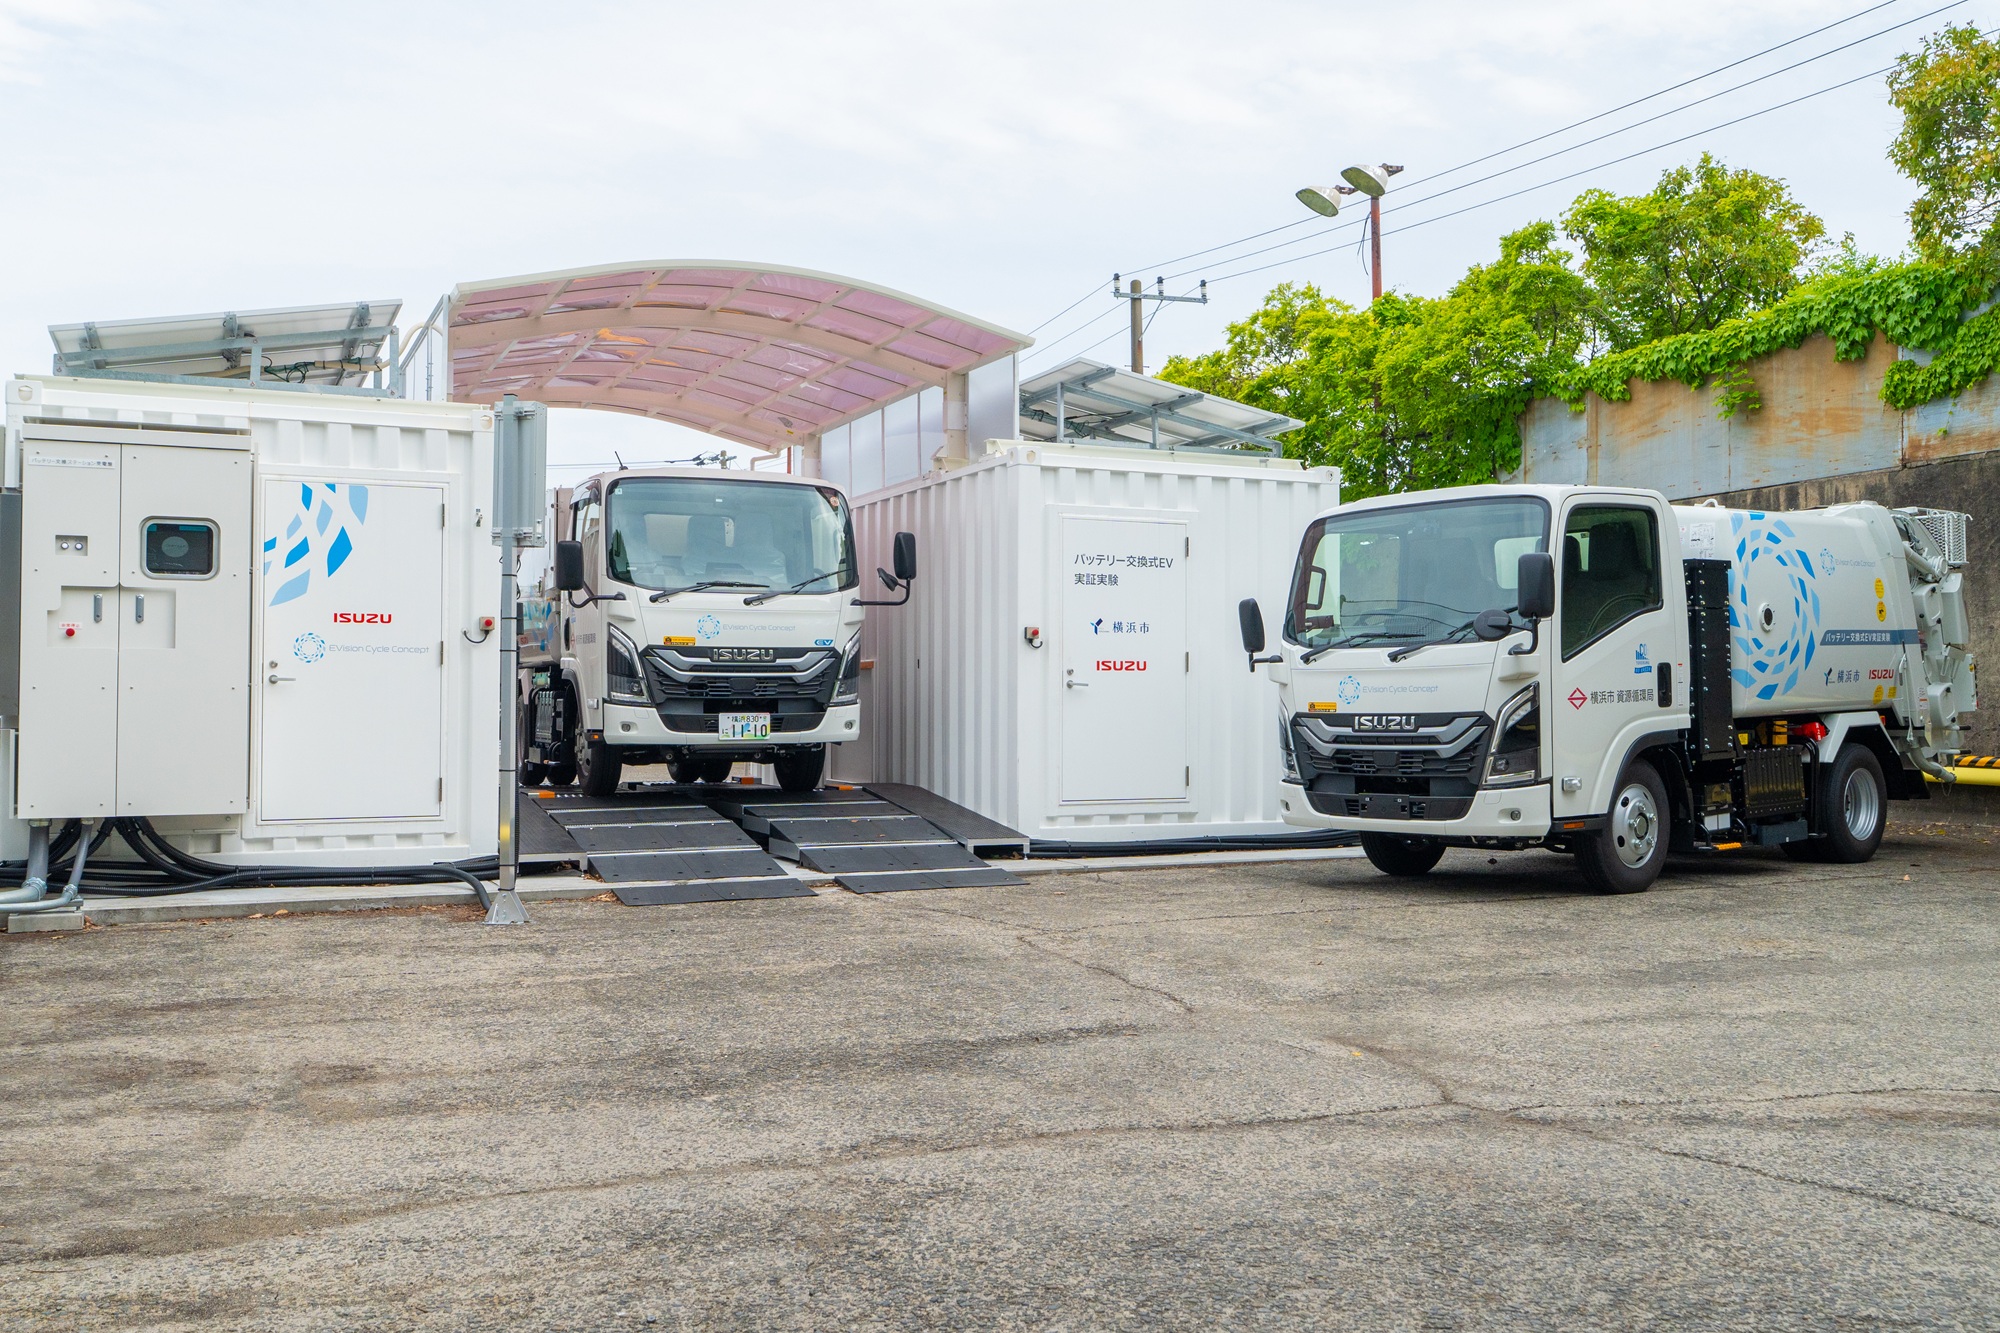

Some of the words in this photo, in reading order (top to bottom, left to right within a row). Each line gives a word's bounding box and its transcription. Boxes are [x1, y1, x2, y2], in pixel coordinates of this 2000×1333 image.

[1074, 553, 1174, 569] バッテリー交換式EV
[1074, 572, 1119, 587] 実証実験
[333, 612, 392, 624] ISUZU
[749, 624, 767, 633] Cycle
[767, 624, 796, 632] Concept
[1112, 621, 1150, 634] 横浜市
[1825, 632, 1891, 642] バッテリー交換式EV実証実験
[328, 644, 364, 653] EVision
[365, 645, 390, 655] Cycle
[391, 645, 430, 654] Concept
[713, 648, 774, 661] ISUZU
[1096, 660, 1147, 671] ISUZU
[1837, 670, 1860, 683] 横浜市
[1868, 669, 1894, 680] ISUZU
[1362, 685, 1388, 694] EVision
[1389, 685, 1408, 695] Cycle
[1408, 685, 1439, 694] Concept
[1590, 690, 1615, 705] 横浜市
[1616, 688, 1654, 704] 資源循環局
[1354, 716, 1415, 730] ISUZU
[732, 724, 768, 737] 11-10
